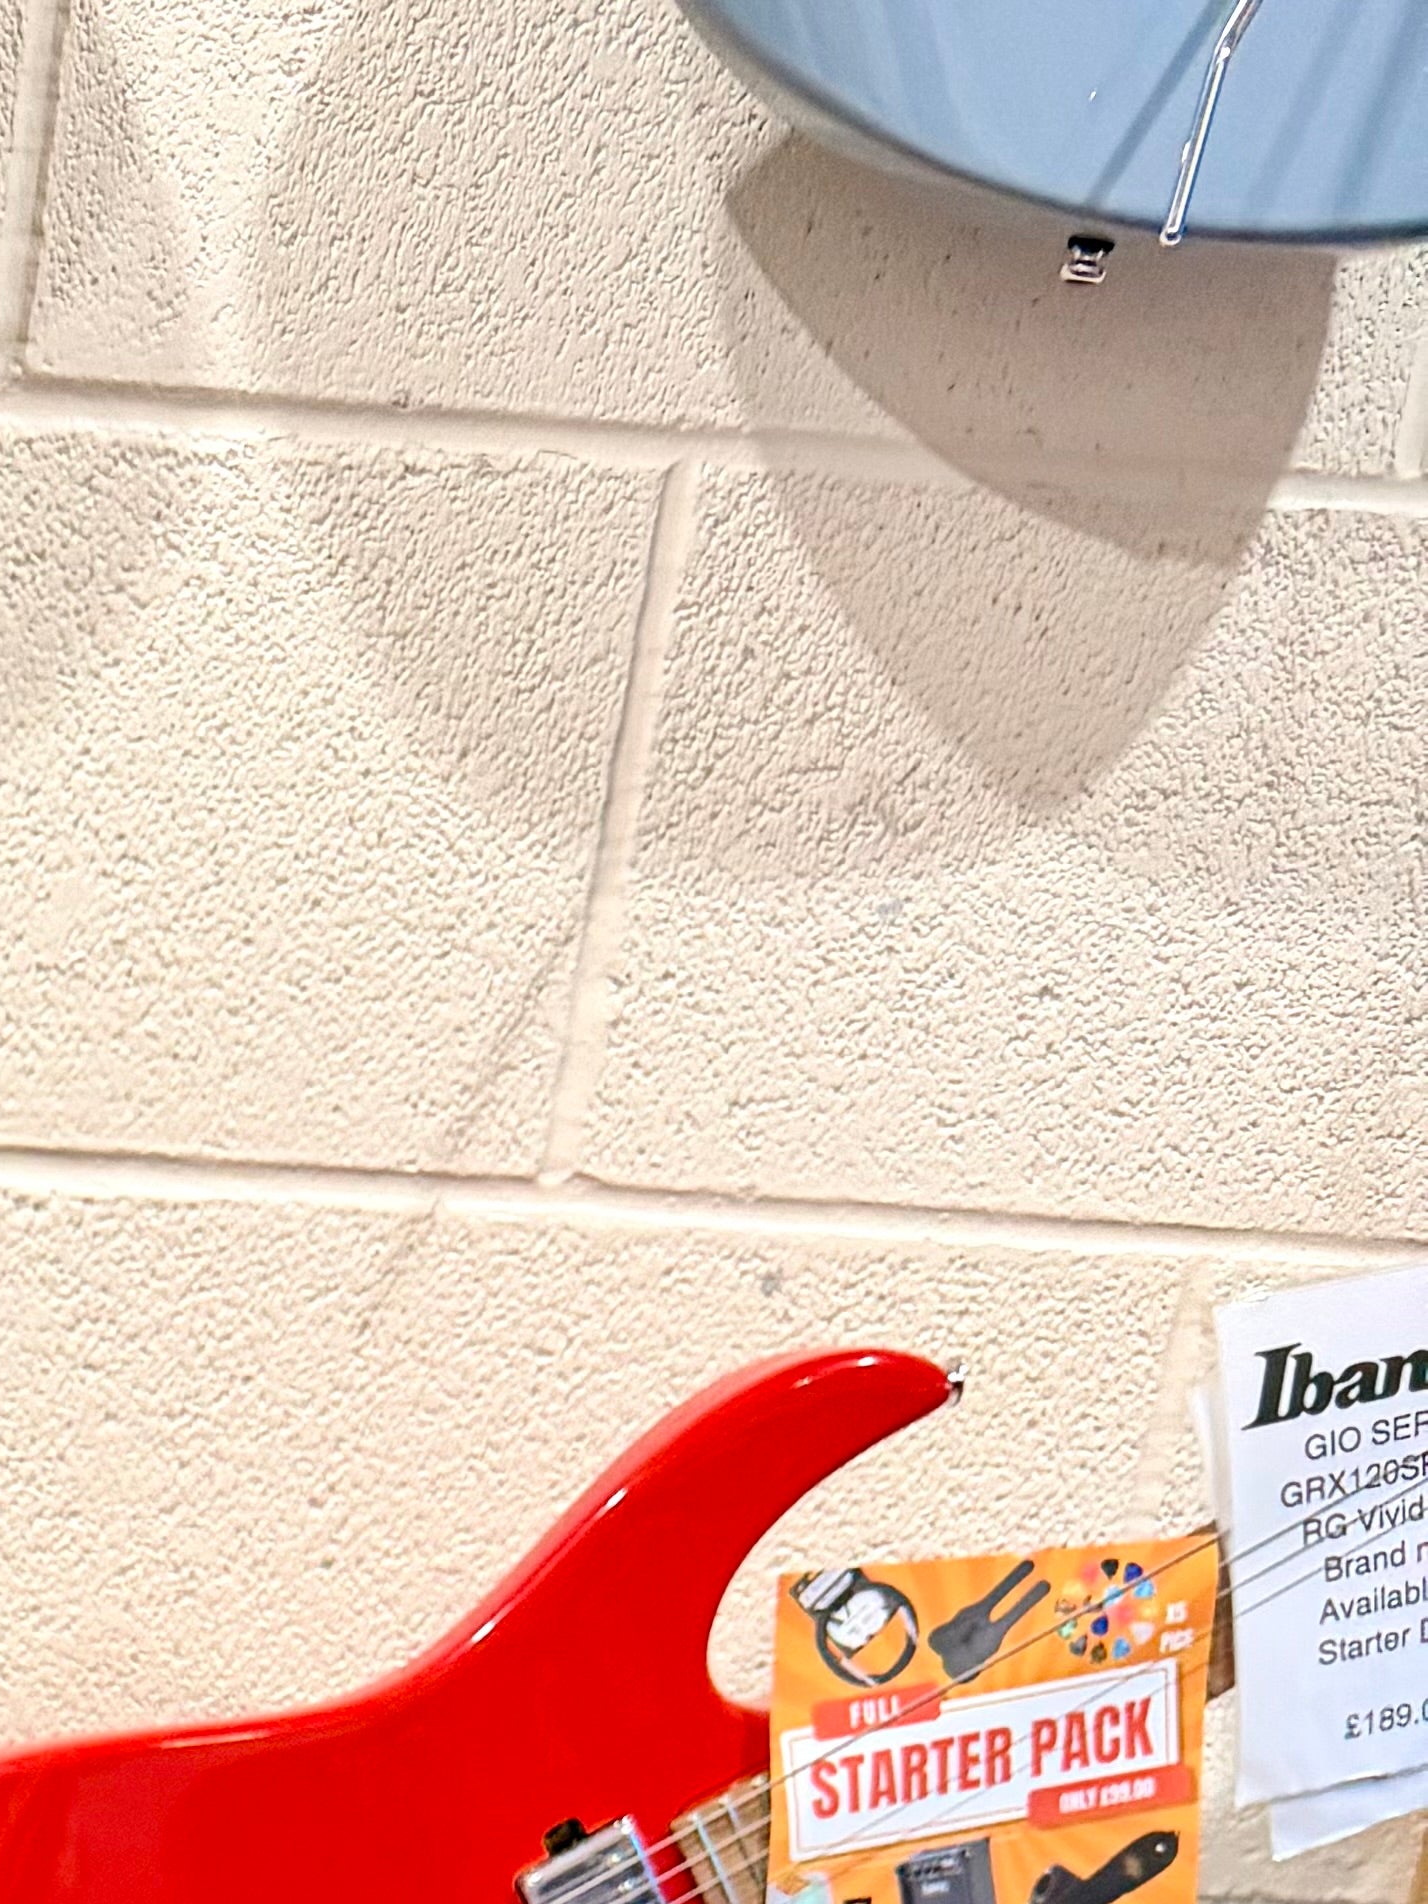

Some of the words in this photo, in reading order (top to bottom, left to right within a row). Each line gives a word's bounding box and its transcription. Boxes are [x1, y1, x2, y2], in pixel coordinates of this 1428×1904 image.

[1304, 1426, 1361, 1461] GIO
[1303, 1515, 1348, 1548] RG
[1357, 1494, 1425, 1533] Vivid
[1324, 1540, 1405, 1583] Brand
[1318, 1628, 1410, 1665] Starter
[810, 1725, 1012, 1819] STARTER
[1032, 1697, 1154, 1777] PACK
